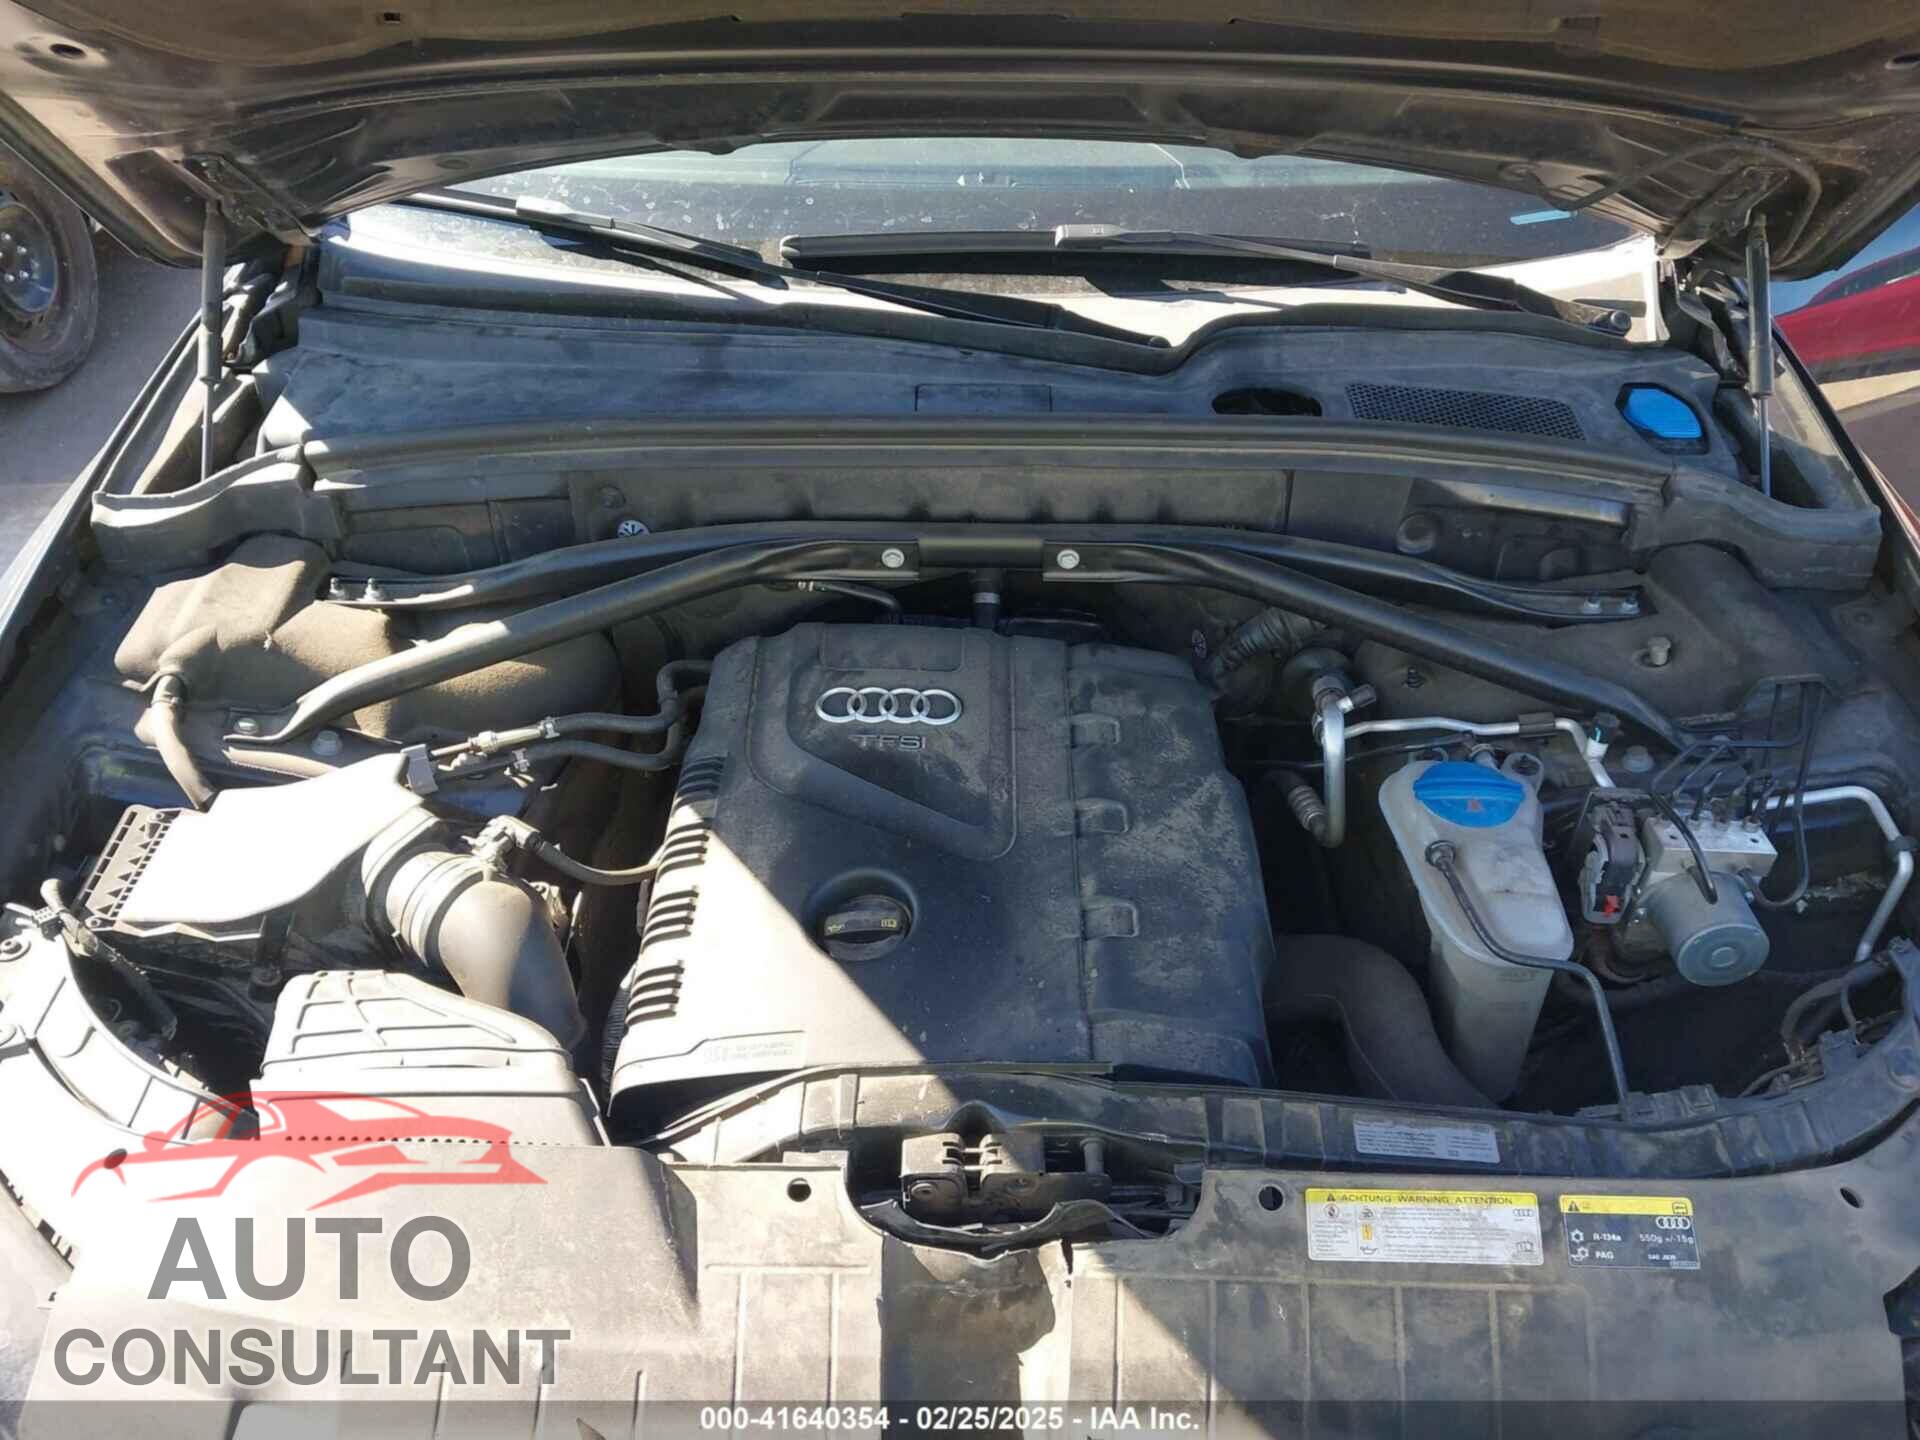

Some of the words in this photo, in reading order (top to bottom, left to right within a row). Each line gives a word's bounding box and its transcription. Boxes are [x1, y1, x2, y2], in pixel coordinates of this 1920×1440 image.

[851, 735, 926, 751] TFSI
[1341, 1194, 1392, 1202] ACHTUNG
[1398, 1195, 1449, 1204] WARNING
[1455, 1196, 1513, 1205] ATTENTION
[1639, 1233, 1663, 1244] 550g
[1595, 1251, 1614, 1260] PAG
